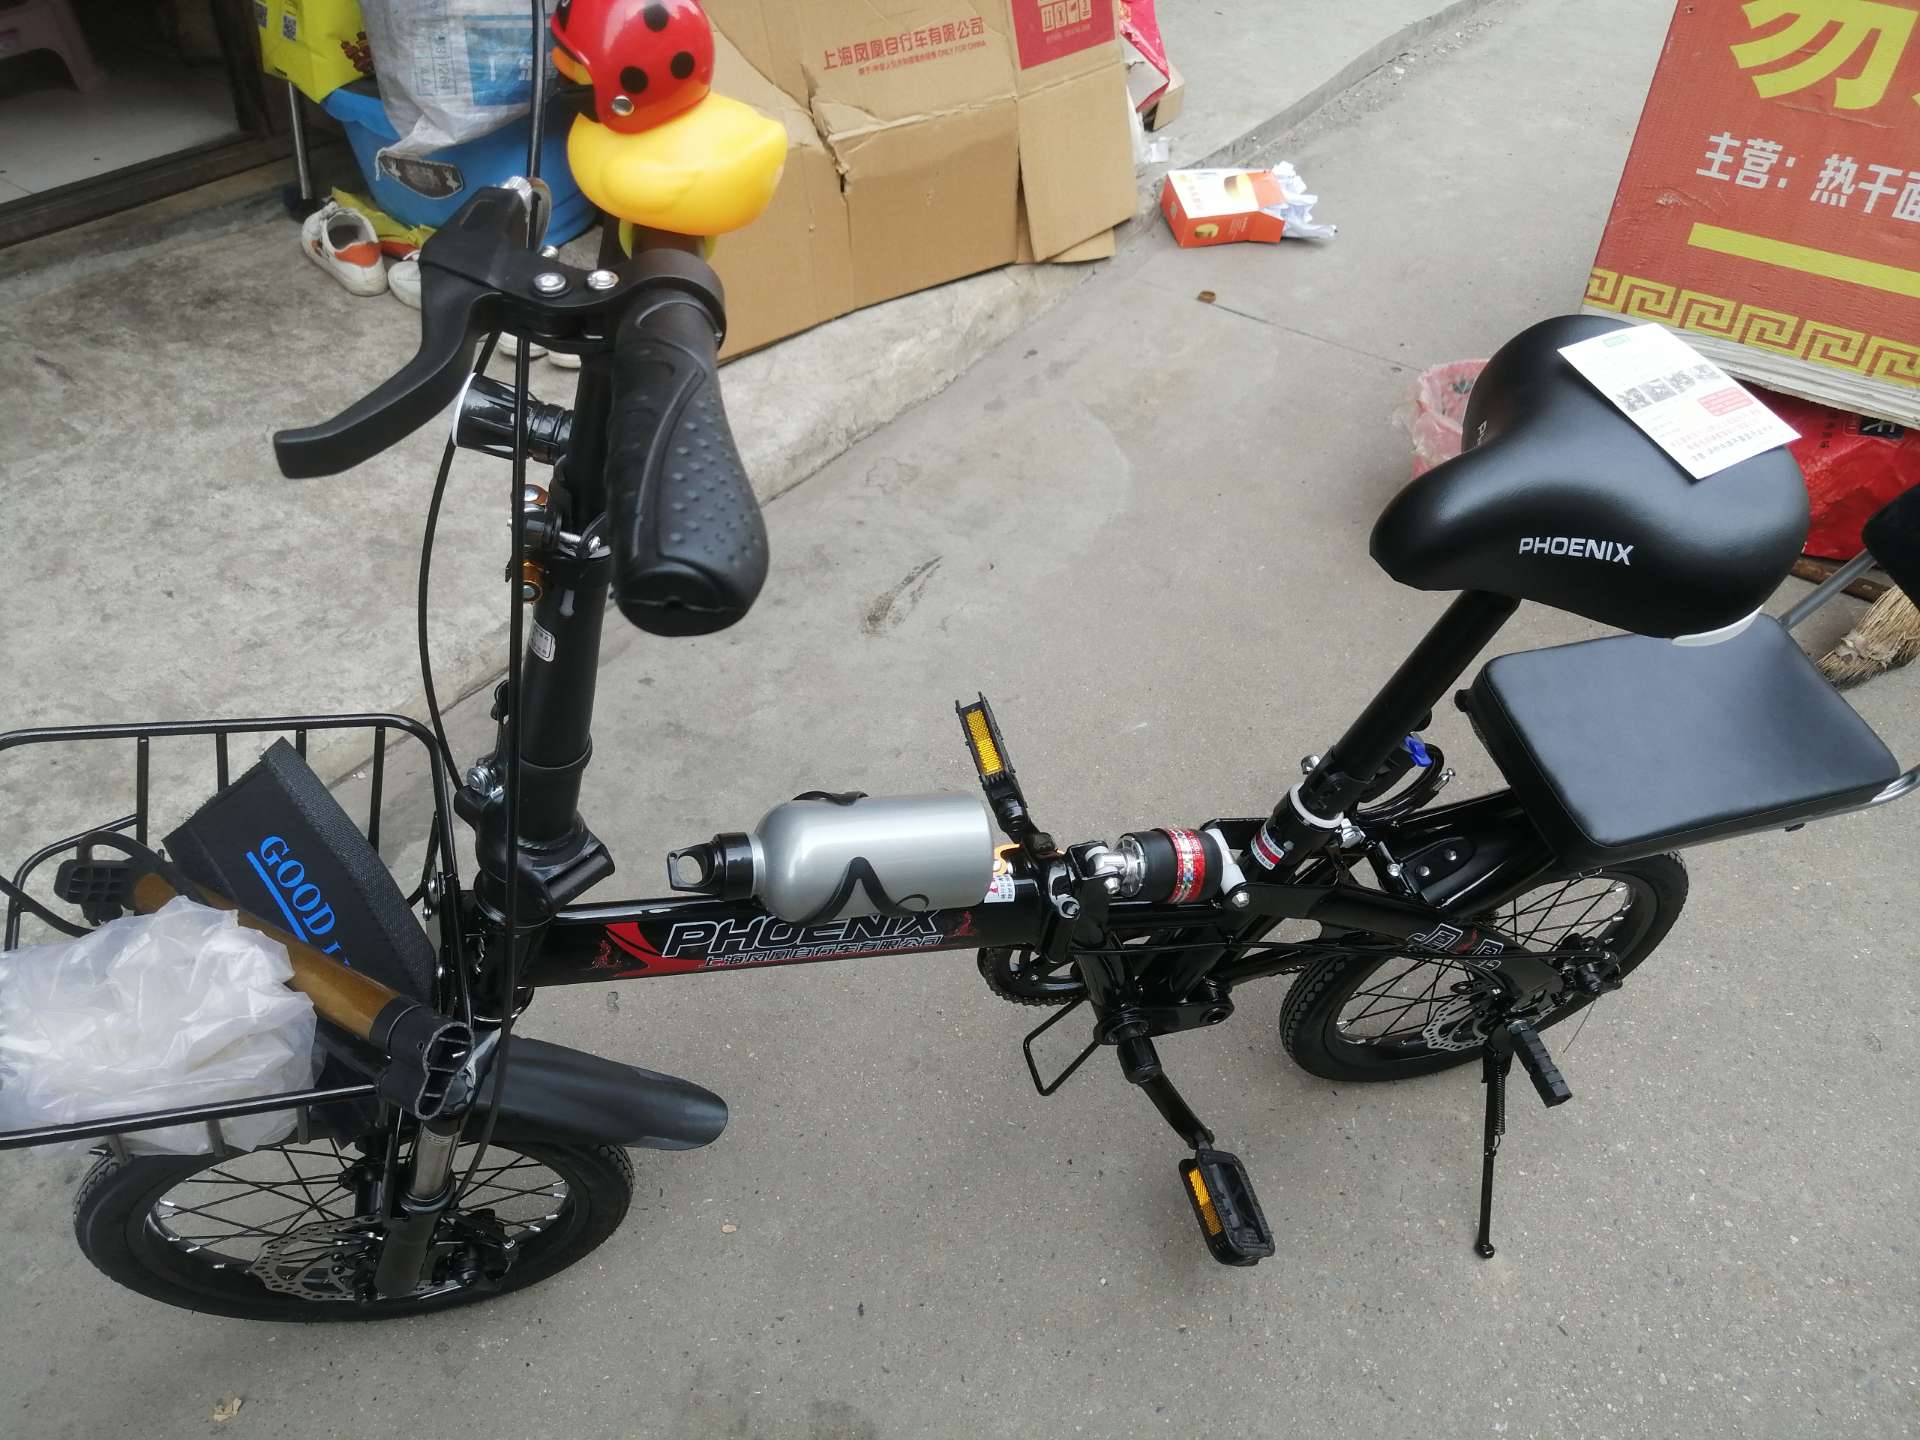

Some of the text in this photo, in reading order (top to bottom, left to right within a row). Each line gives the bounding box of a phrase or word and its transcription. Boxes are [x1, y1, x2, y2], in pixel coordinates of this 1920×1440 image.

[823, 16, 985, 71] 上海凤凰自行车有限公司
[1729, 0, 1920, 110] 勿
[1518, 536, 1635, 566] PHOENIX
[260, 836, 336, 935] GOOD
[662, 909, 941, 958] PHOENIX
